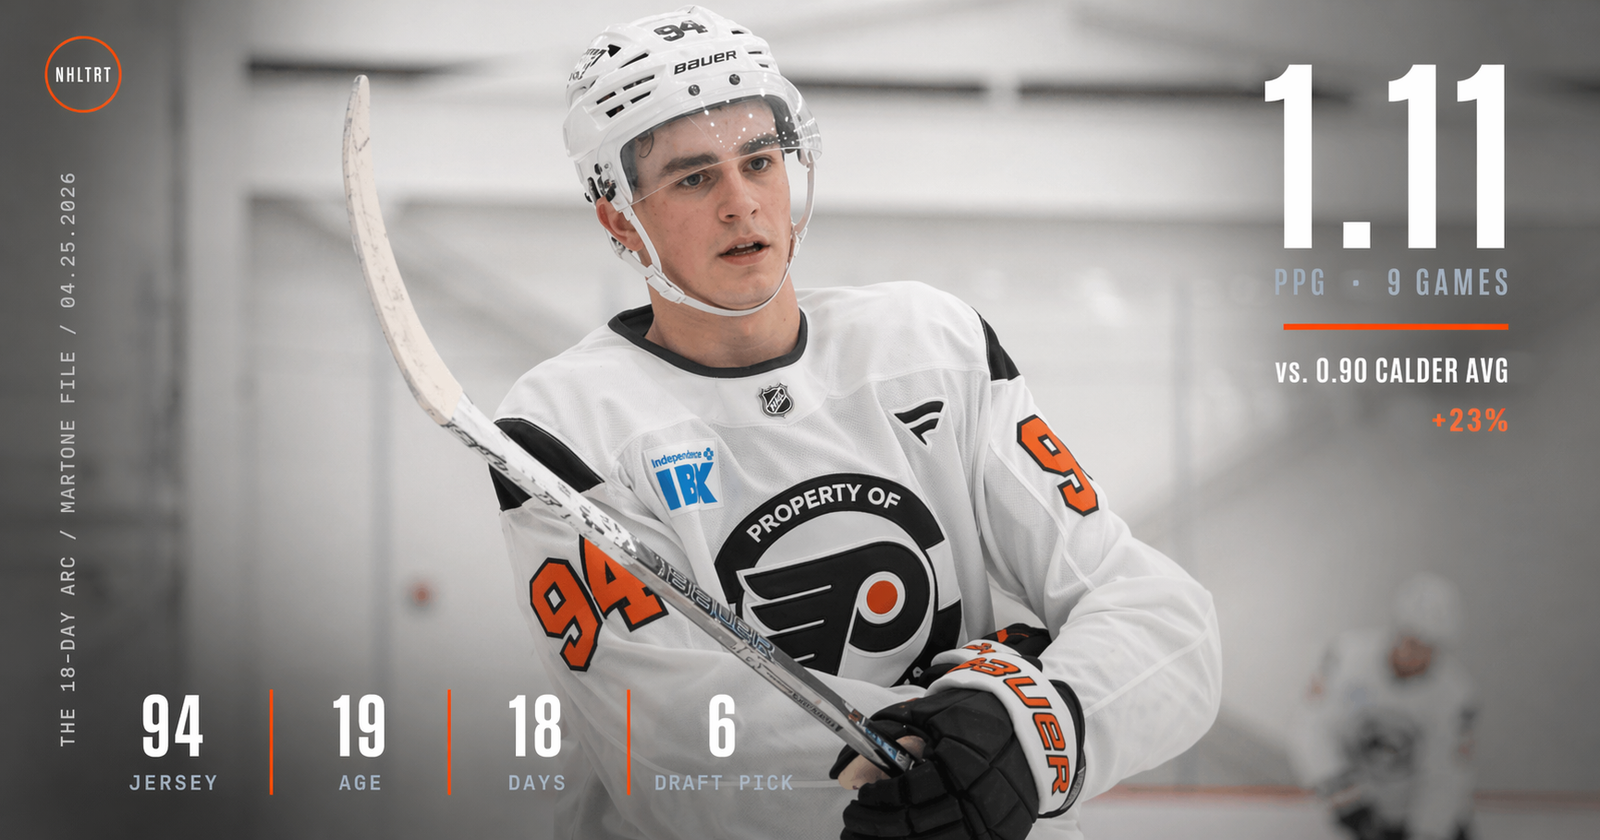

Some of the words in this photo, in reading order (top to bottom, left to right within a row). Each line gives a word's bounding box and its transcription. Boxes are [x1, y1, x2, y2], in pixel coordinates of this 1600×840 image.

[653, 19, 709, 42] 94
[673, 49, 738, 75] BAUER
[746, 483, 862, 543] PROPERTY
[867, 486, 902, 510] OF
[529, 533, 670, 673] 94
